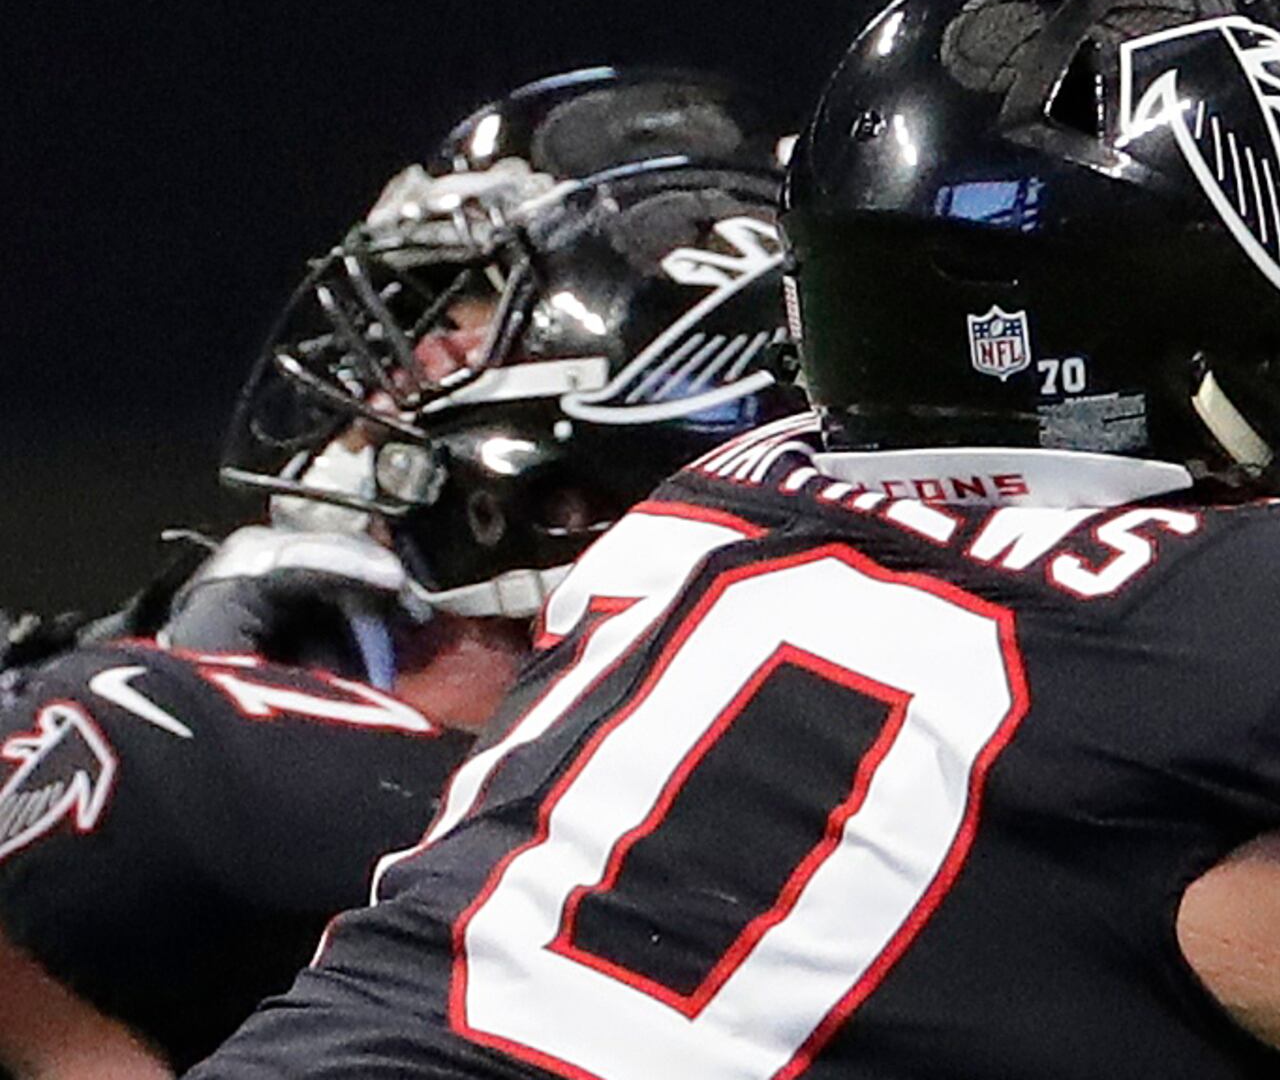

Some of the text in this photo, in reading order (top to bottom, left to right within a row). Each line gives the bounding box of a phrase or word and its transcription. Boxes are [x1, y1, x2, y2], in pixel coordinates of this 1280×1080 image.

[979, 340, 1024, 369] NFL
[1037, 357, 1086, 395] 70
[372, 501, 1031, 1080] 70
